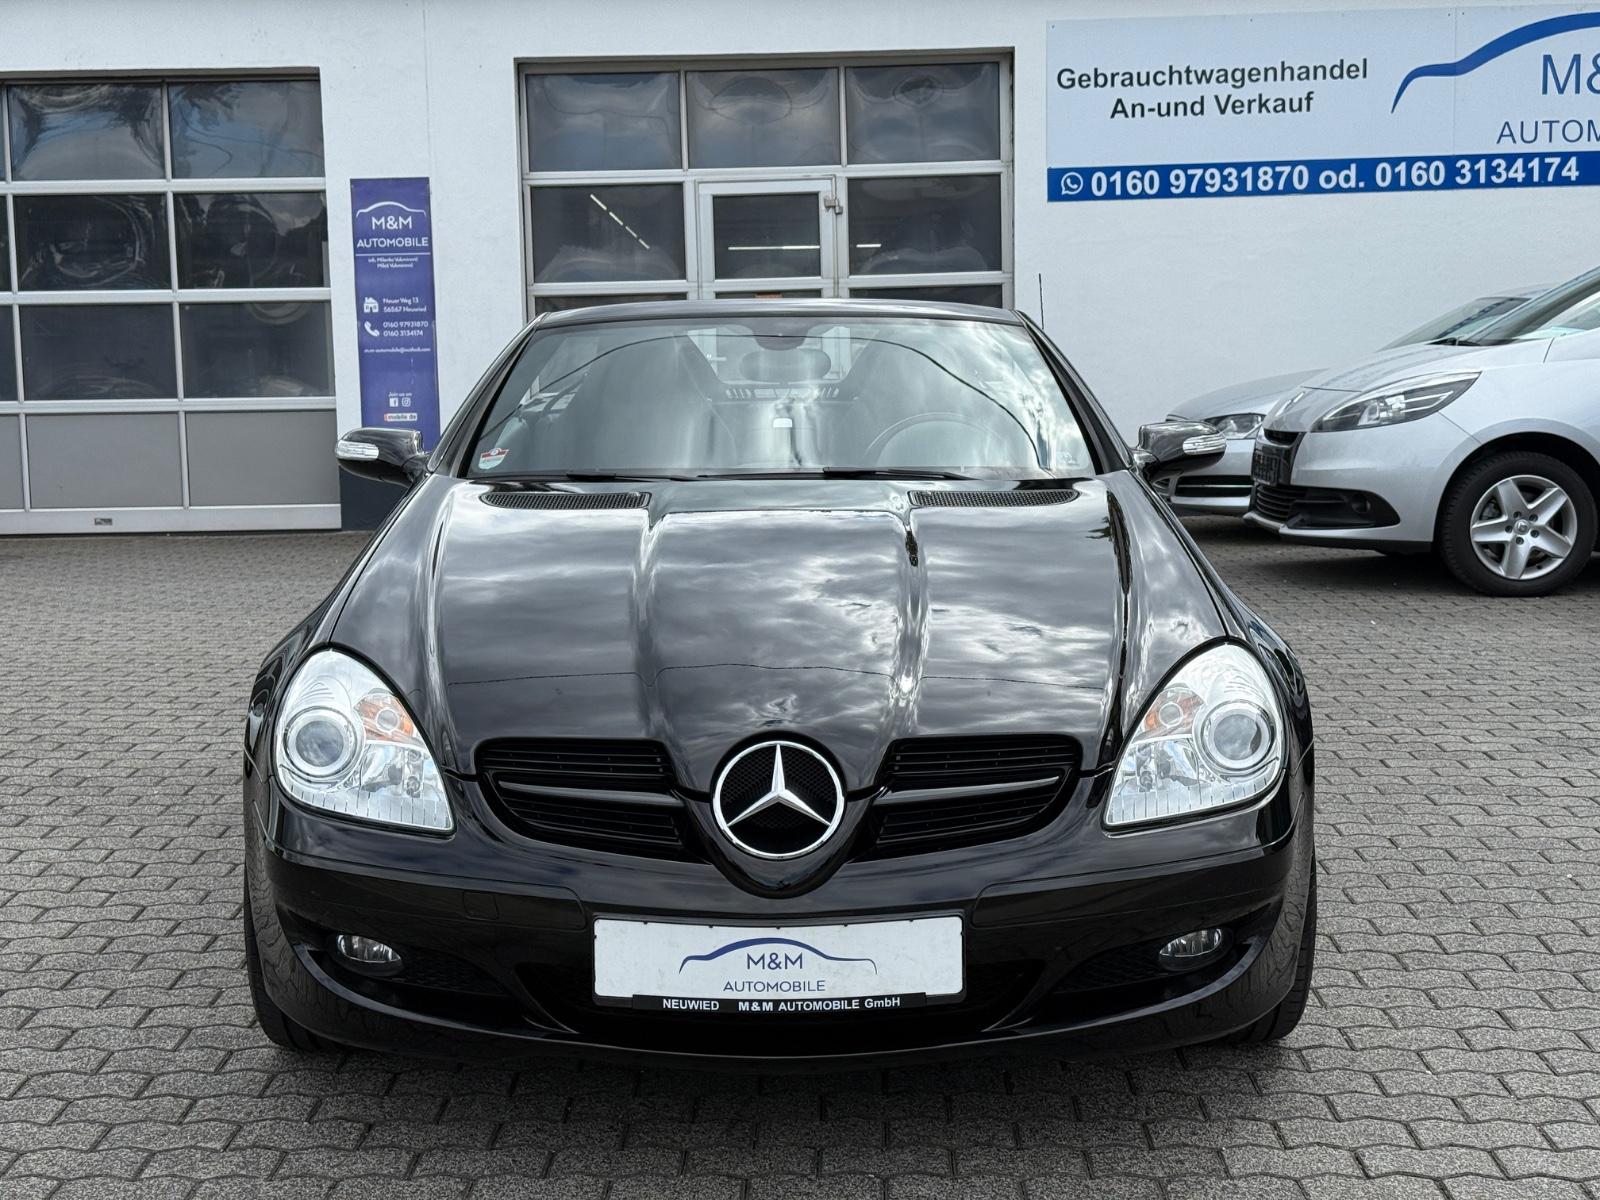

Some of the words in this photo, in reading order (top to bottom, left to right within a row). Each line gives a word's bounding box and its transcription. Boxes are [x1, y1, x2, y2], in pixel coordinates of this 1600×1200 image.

[1056, 58, 1368, 90] Gebrauchtwagenhandel
[1110, 96, 1206, 119] An-und
[1214, 91, 1315, 116] Verkauf
[1091, 170, 1160, 197] 0160
[1169, 165, 1309, 194] 97931870
[1318, 163, 1365, 189] od.
[1375, 160, 1446, 188] 0160
[1455, 156, 1580, 185] 3134174
[371, 215, 412, 230] M&M
[356, 236, 429, 249] AUTOMOBILE
[746, 952, 803, 970] M&M
[723, 980, 826, 992] AUTOMOBILE
[662, 998, 720, 1011] NEUWIED
[738, 1001, 774, 1012] M&M
[778, 999, 860, 1012] AUTOMOBILE
[864, 997, 901, 1009] GmbH
